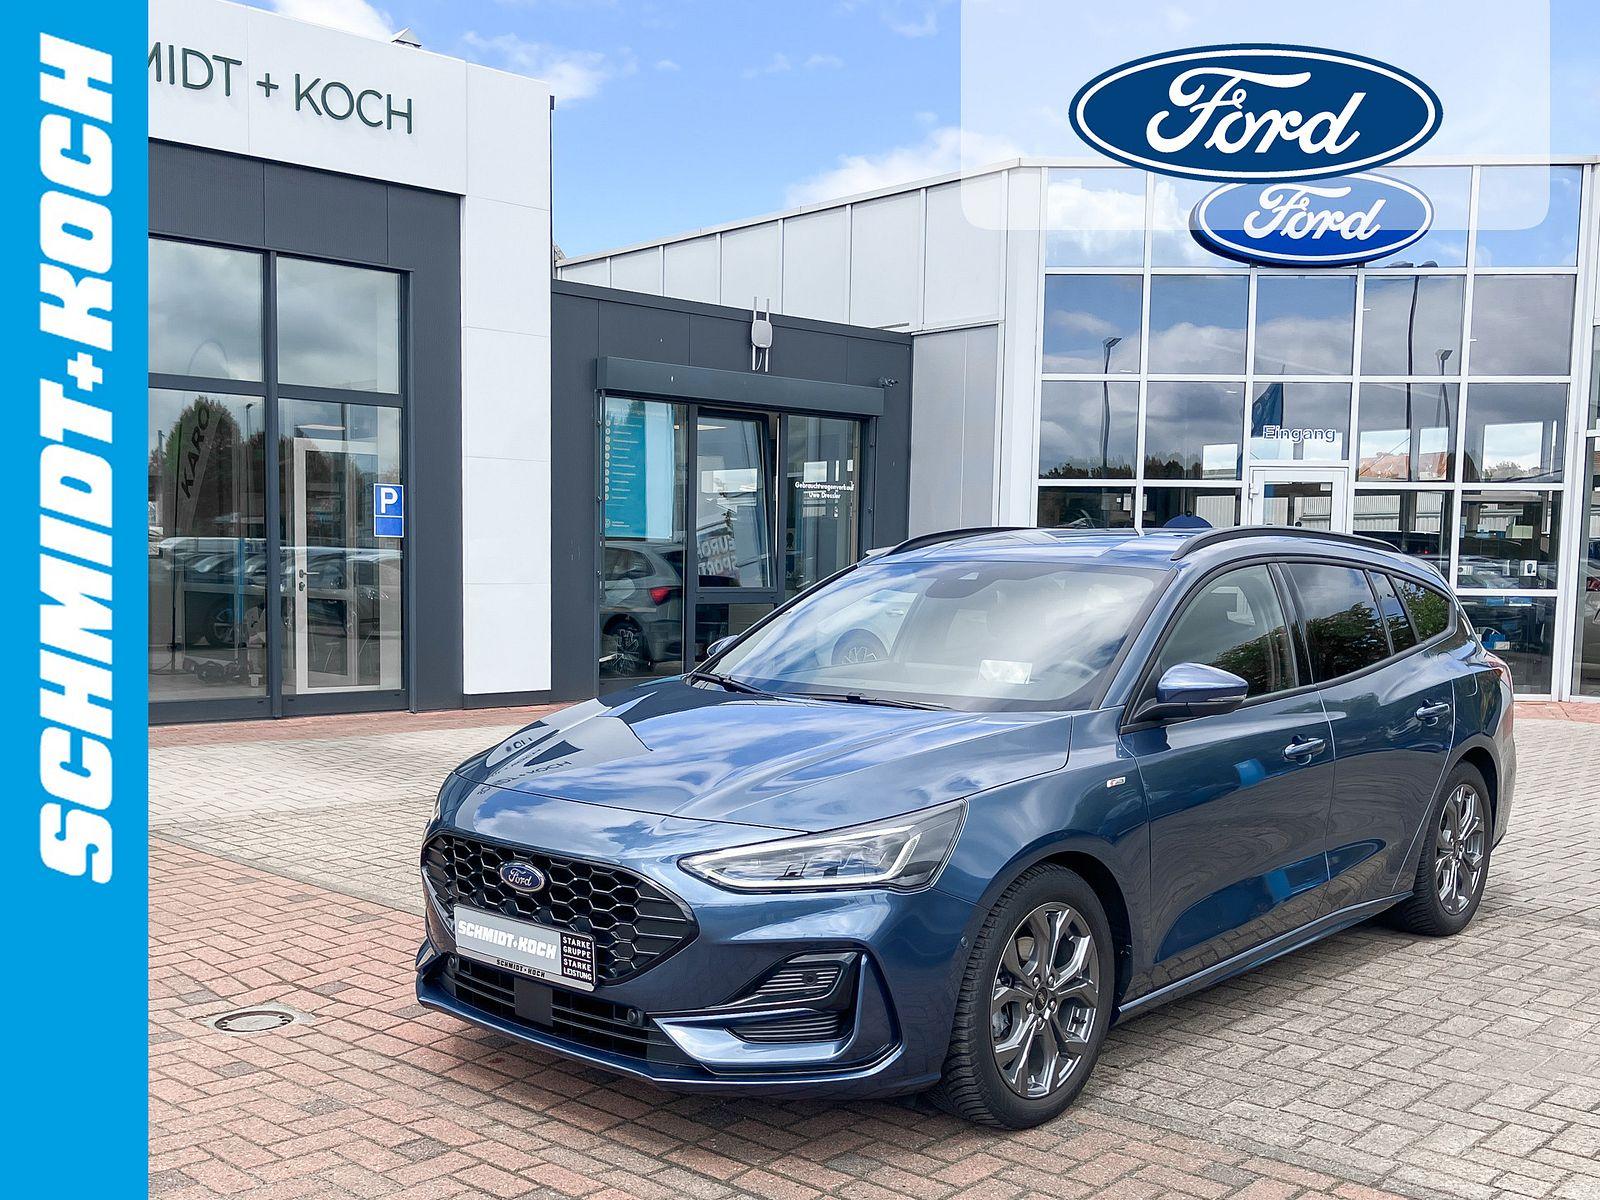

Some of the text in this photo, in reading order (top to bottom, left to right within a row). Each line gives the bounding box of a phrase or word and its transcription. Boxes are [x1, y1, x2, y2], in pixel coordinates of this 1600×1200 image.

[256, 73, 279, 97] +
[294, 73, 413, 134] KOCH
[1243, 184, 1387, 241] Ford
[1263, 425, 1337, 443] Eingang
[181, 407, 210, 499] KARO
[380, 487, 399, 514] P
[508, 867, 533, 887] Ford
[563, 936, 591, 950] STARKE
[563, 946, 592, 959] GRUPPE
[563, 958, 592, 972] STARKE
[563, 967, 592, 981] LEISTUNG
